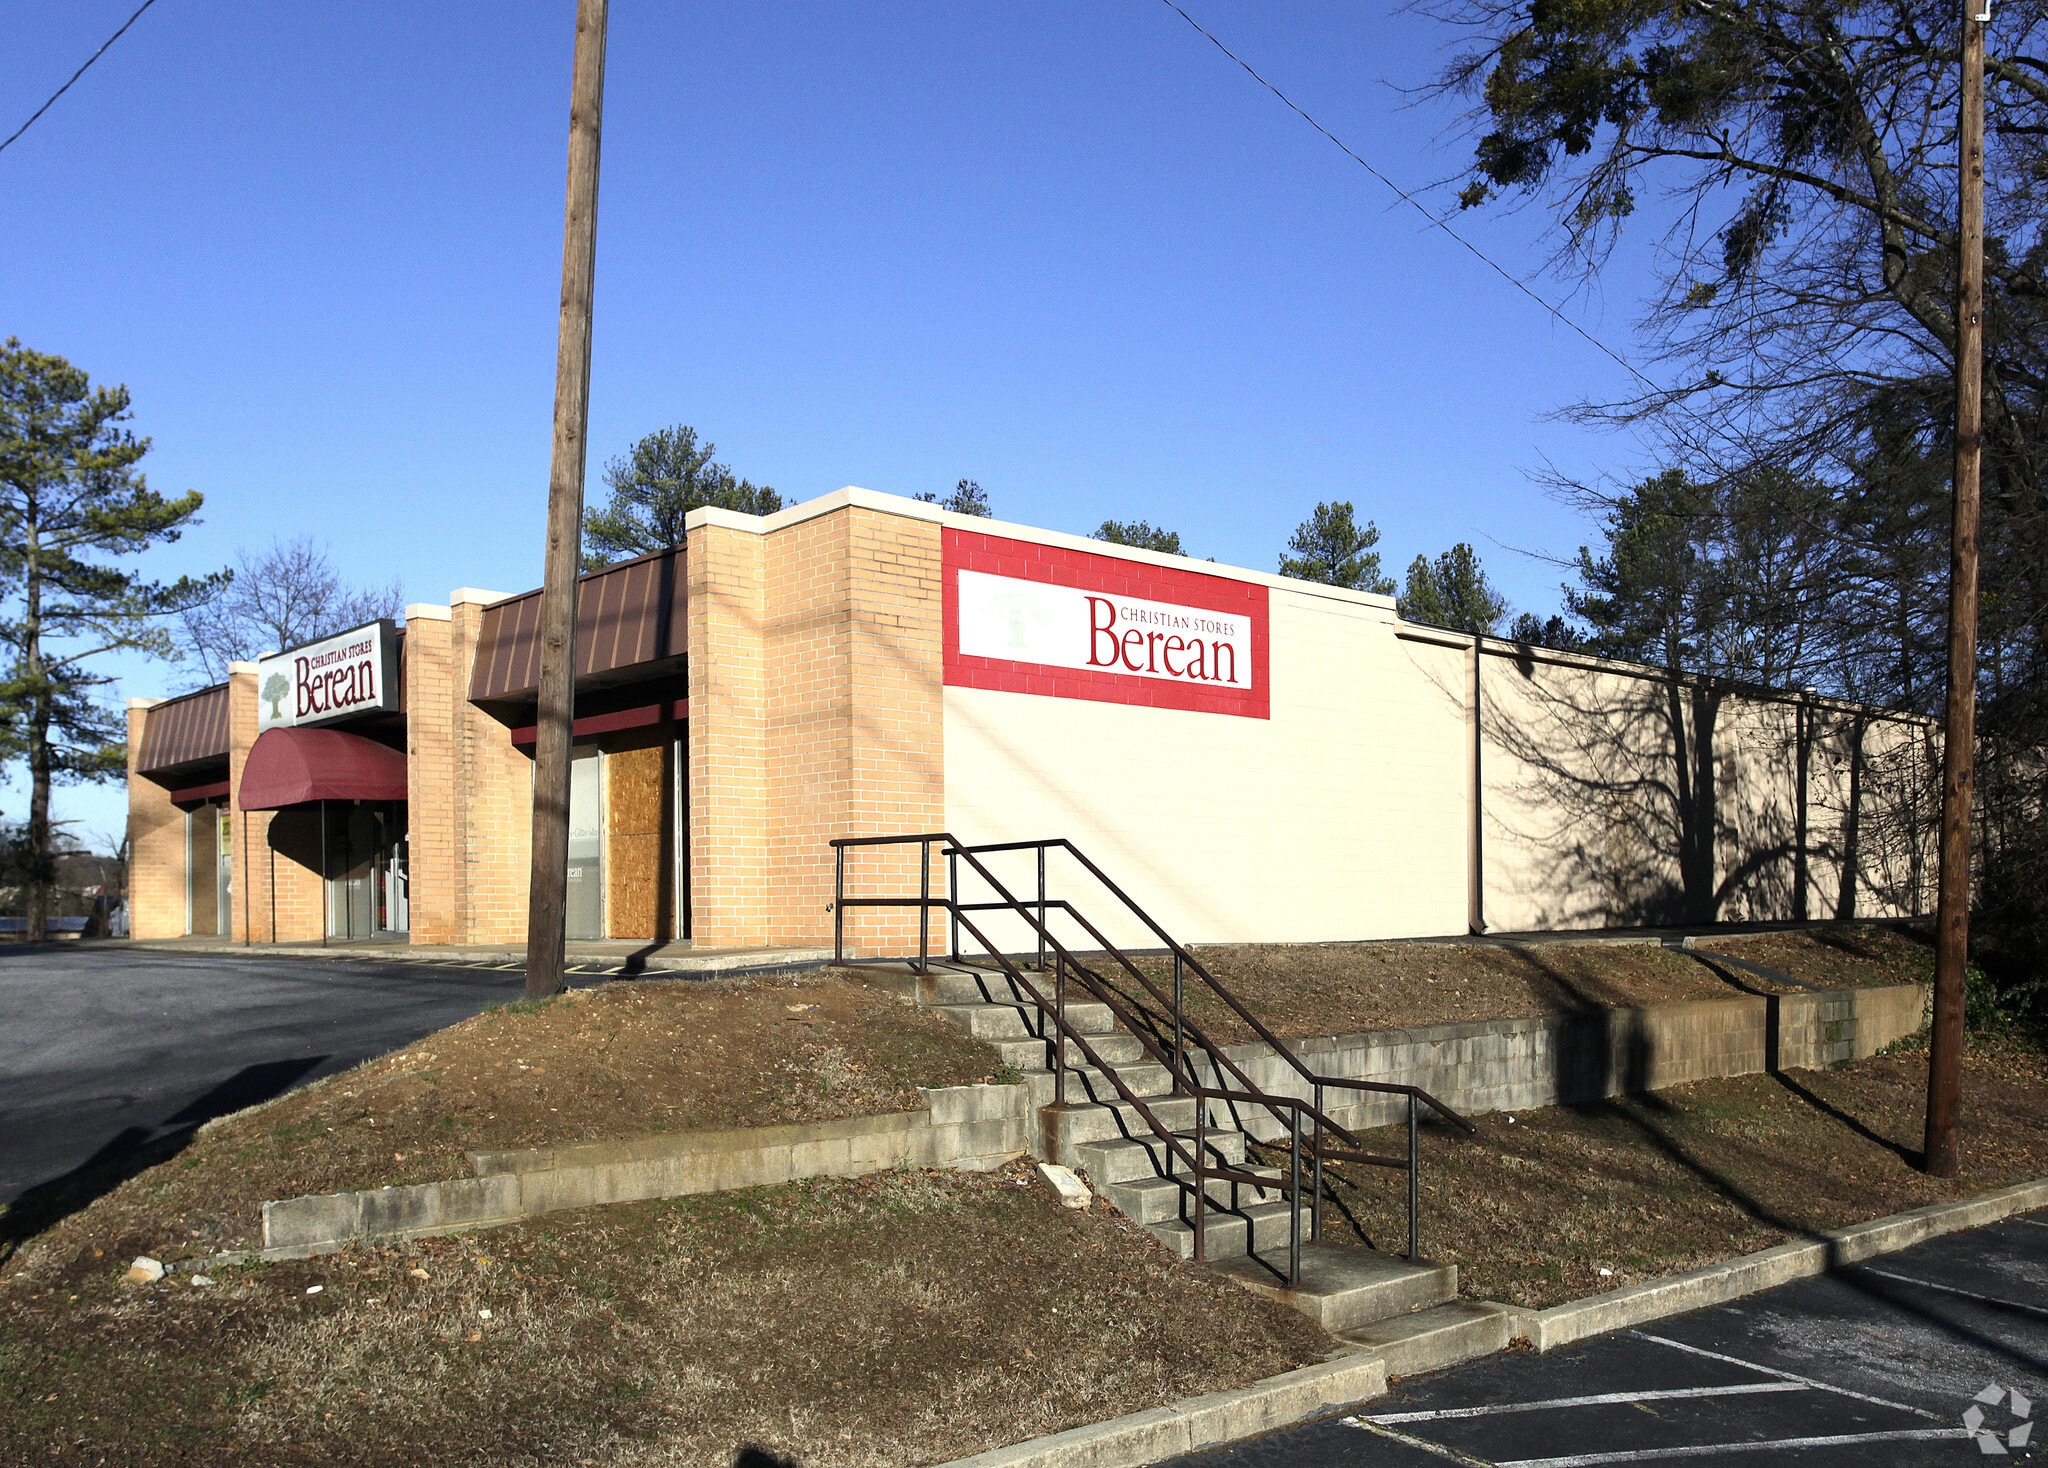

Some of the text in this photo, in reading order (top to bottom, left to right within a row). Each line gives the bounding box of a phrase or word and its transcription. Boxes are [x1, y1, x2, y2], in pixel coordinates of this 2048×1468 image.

[1084, 596, 1239, 684] Berean
[1120, 606, 1236, 637] CHRISTIAN STORES
[311, 639, 372, 670] CHRISTIAN STORES
[294, 656, 376, 718] Berean
